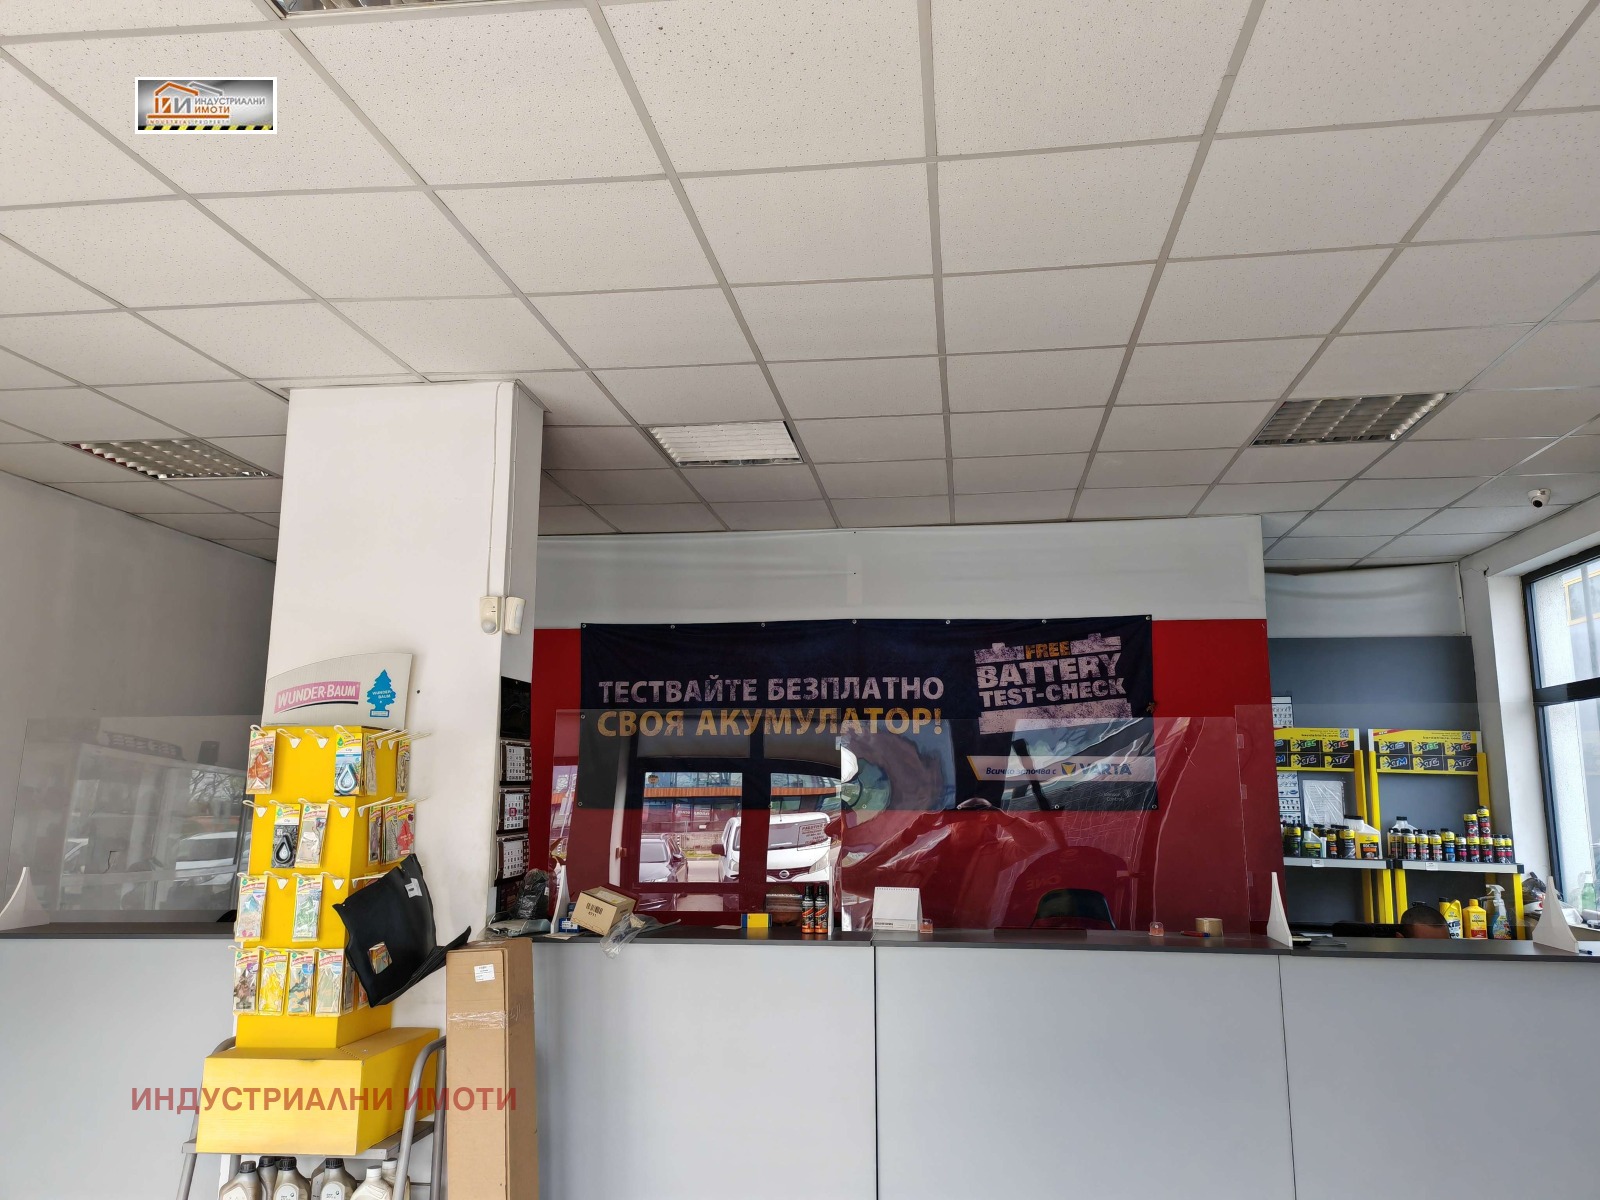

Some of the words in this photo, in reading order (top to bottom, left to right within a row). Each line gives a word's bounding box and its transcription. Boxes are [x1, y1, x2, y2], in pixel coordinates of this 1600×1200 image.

[1024, 640, 1072, 660] FREE
[976, 652, 1122, 689] BATTERY
[277, 683, 356, 709] WUNDER-BAUM
[598, 674, 758, 704] ТЕСТВАЙТЕ
[767, 676, 945, 702] БЕЗПЛАТНО
[978, 677, 1127, 708] TEST-CHECK
[597, 709, 685, 738] СВОЯ
[695, 707, 943, 737] АКУМУЛАТОР!
[985, 766, 1015, 775] Всичко
[1079, 763, 1132, 776] VARTA
[1329, 755, 1350, 766] ATF
[1453, 758, 1474, 769] ATF
